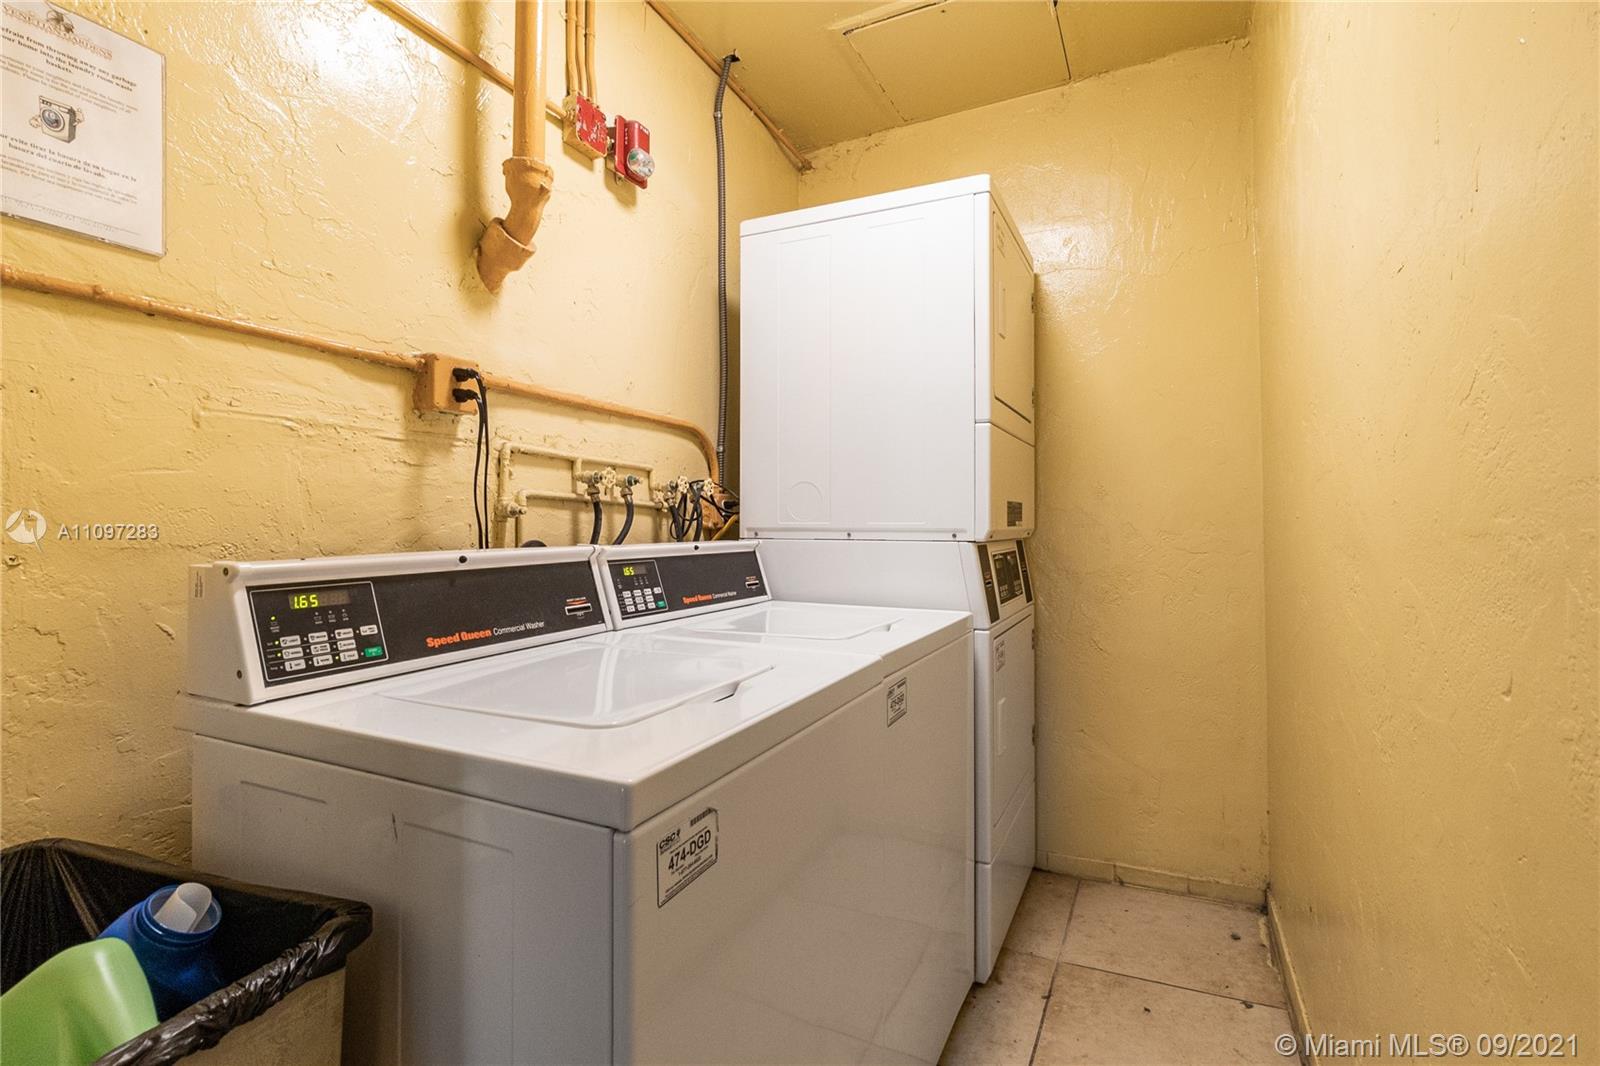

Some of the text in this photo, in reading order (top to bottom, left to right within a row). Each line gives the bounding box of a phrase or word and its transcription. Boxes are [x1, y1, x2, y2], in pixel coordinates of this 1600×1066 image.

[1, 25, 23, 39] efrain
[26, 35, 44, 47] from
[46, 44, 76, 62] throwing
[79, 59, 95, 70] away
[111, 72, 136, 87] garbage
[1, 34, 14, 43] our
[17, 39, 37, 52] home
[40, 49, 53, 59] into
[55, 56, 65, 64] the
[68, 61, 93, 75] laundry
[96, 74, 113, 84] room
[425, 620, 545, 648] Speed Queen Commercial Washer
[668, 829, 711, 870] 474-DGD
